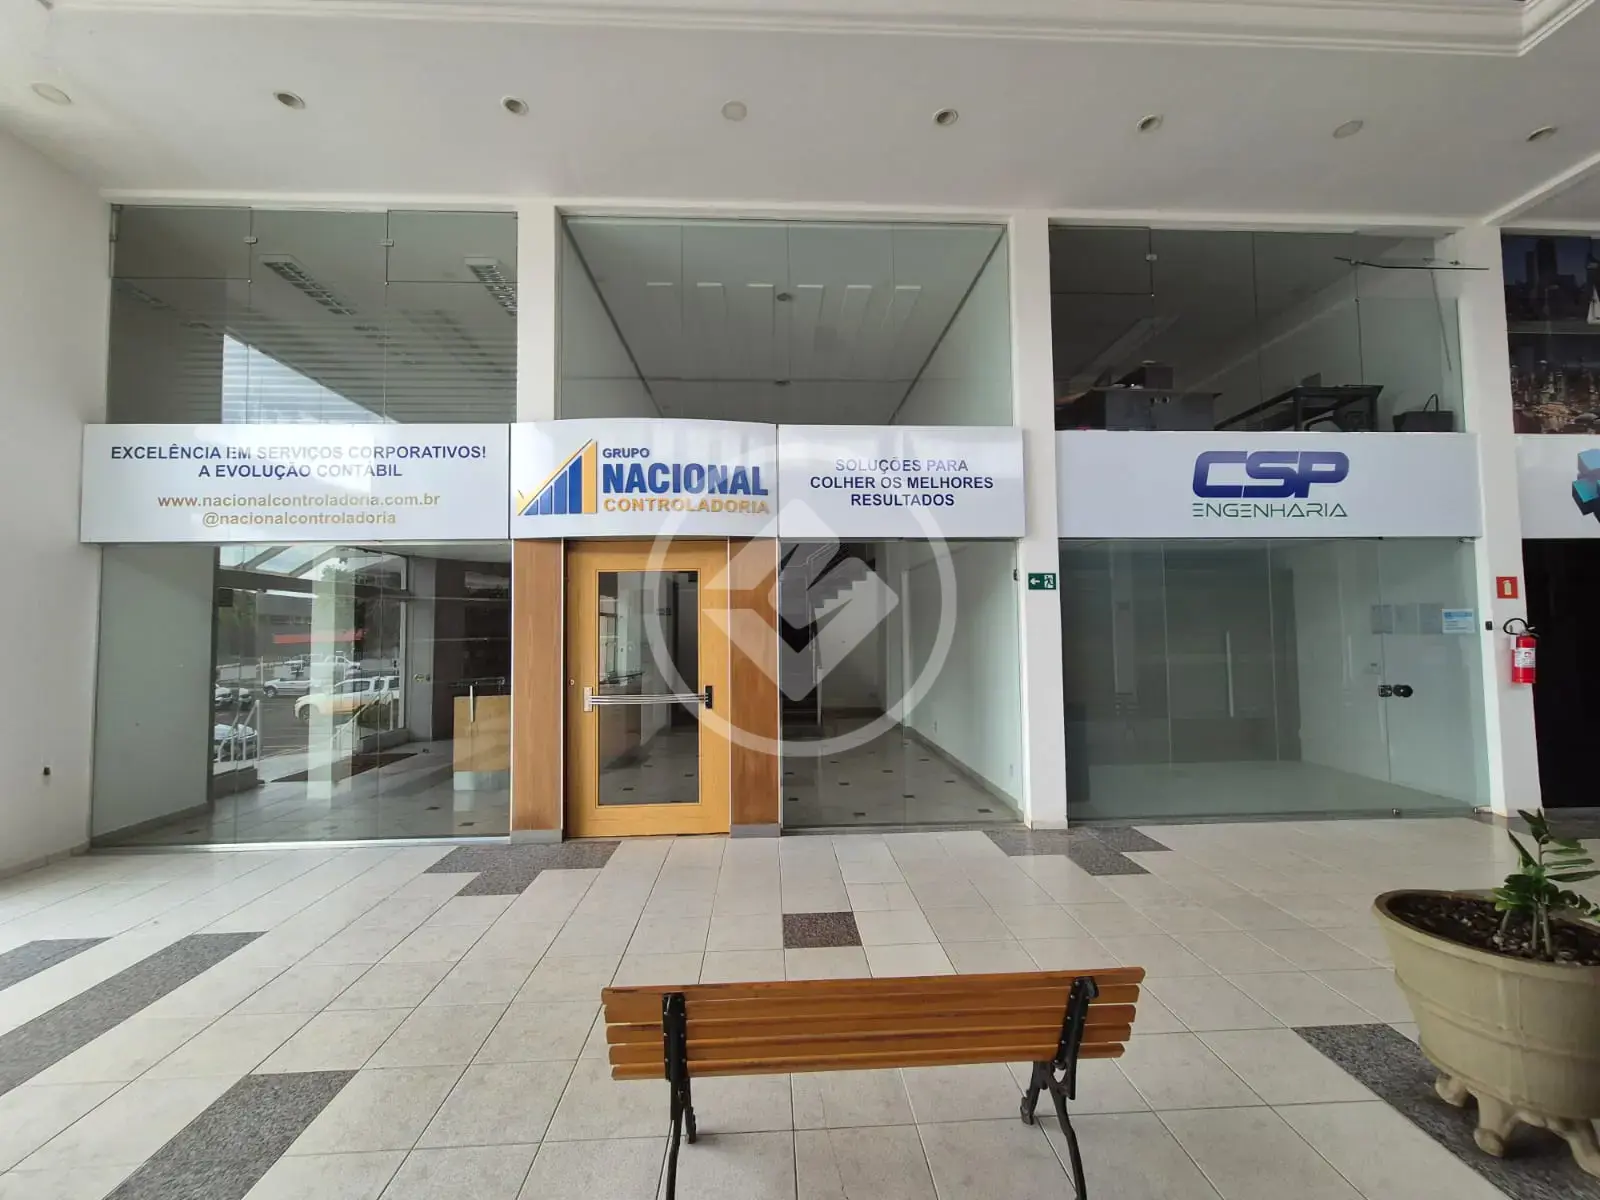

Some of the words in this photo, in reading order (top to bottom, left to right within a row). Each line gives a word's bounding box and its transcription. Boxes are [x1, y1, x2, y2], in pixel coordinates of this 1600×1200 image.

[110, 443, 222, 460] EXCELÊNCIA
[226, 446, 251, 459] EM
[256, 446, 344, 462] SERVIÇOS
[348, 445, 487, 459] CORPORATIVOS!
[602, 447, 650, 459] GRUPO
[198, 464, 211, 478] A
[215, 462, 311, 480] EVOLUÇÃO
[316, 461, 403, 478] CONTÁBIL
[835, 457, 922, 475] SOLUÇÕES
[926, 459, 969, 472] PARA
[1192, 450, 1350, 498] CSP
[602, 462, 769, 496] NACIONAL
[810, 476, 876, 489] COLHER
[880, 476, 902, 489] OS
[907, 476, 994, 489] MELHORES
[158, 492, 440, 507] www.nacionalcontroladoria.com.br
[602, 497, 770, 515] CONTROLADORIA
[850, 493, 955, 507] RESULTADOS
[1191, 502, 1349, 518] ENGENHARIA
[202, 511, 396, 527] @nacionalcontroladoria
